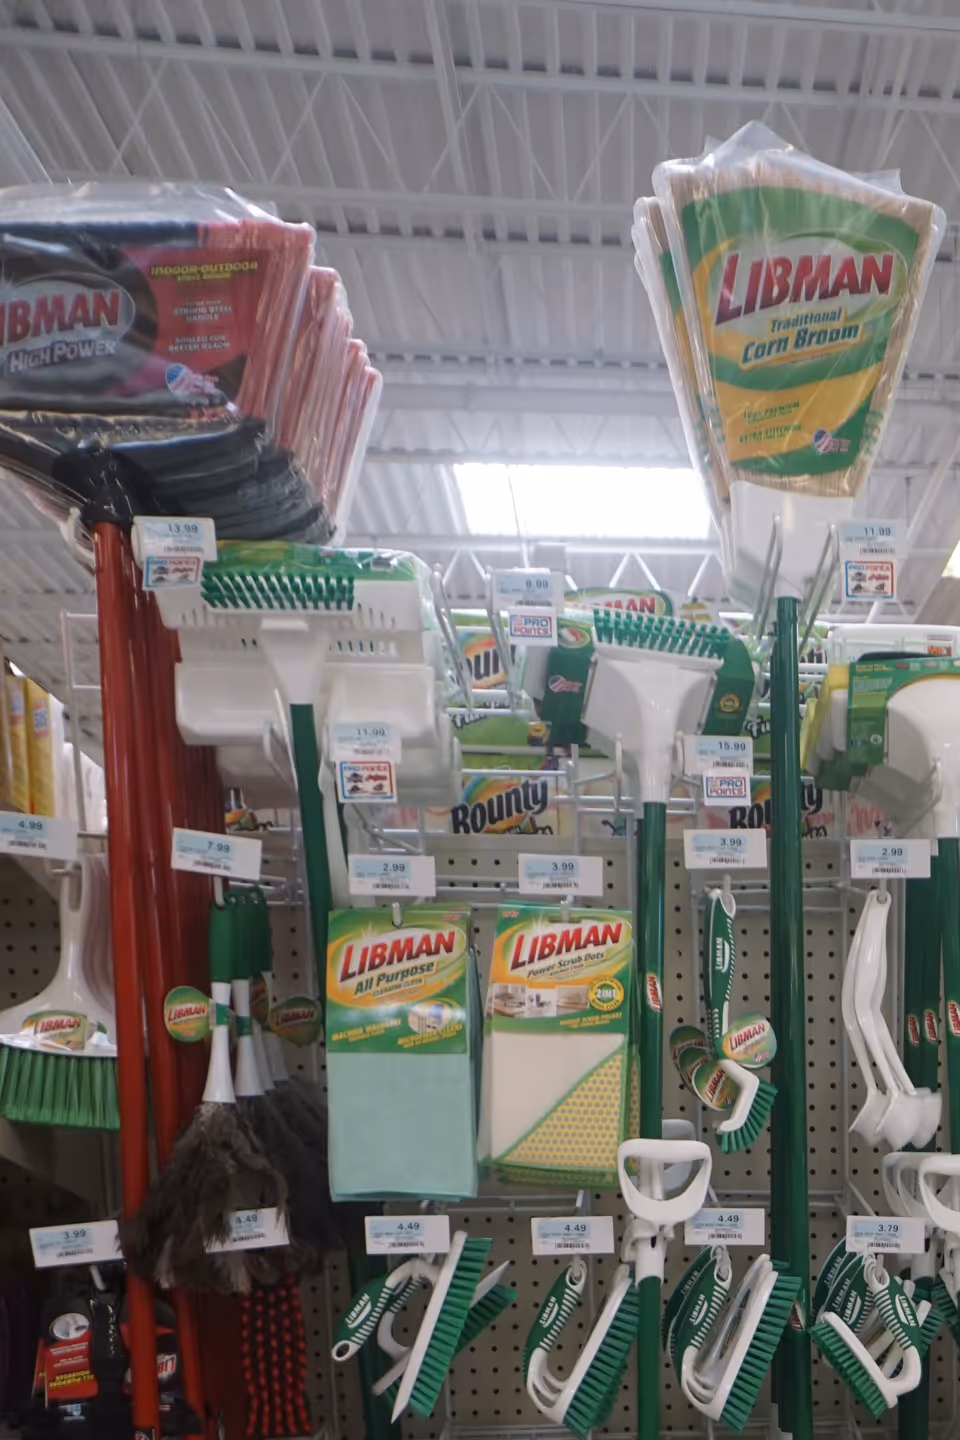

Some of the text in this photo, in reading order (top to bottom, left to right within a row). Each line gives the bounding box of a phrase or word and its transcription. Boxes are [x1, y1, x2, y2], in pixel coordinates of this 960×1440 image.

[715, 253, 894, 326] LIBMAN
[771, 309, 842, 332] Traditional
[742, 324, 860, 364] Corn Broom
[9, 340, 116, 373] HIGH POWER
[524, 618, 548, 628] PRO
[709, 777, 744, 796] PRO POINTS
[18, 821, 42, 830] 4.99
[208, 841, 230, 852] 7.99
[720, 838, 742, 847] 3.99
[882, 848, 903, 857] 2.99
[382, 863, 405, 872] 2.99
[552, 862, 575, 871] 3.99
[510, 922, 622, 971] LIBMAN
[715, 937, 723, 970] LIBMAN
[340, 930, 455, 982] LIBMAN
[354, 962, 434, 996] All Purpose
[527, 962, 561, 978] Power
[168, 1006, 206, 1023] LIBMAN
[34, 1016, 82, 1034] LIBMAN
[728, 1023, 766, 1051] LIBMAN
[397, 1222, 420, 1231] 4.49
[718, 1214, 740, 1223] 4.49
[64, 1229, 87, 1239] 3.99
[564, 1224, 587, 1233] 4.49
[878, 1224, 899, 1232] 3.79
[345, 1292, 370, 1327] LIBMAN
[539, 1296, 556, 1325] LIBMAN
[688, 1294, 705, 1324] LIBMAN
[900, 1295, 916, 1327] LIBMAN
